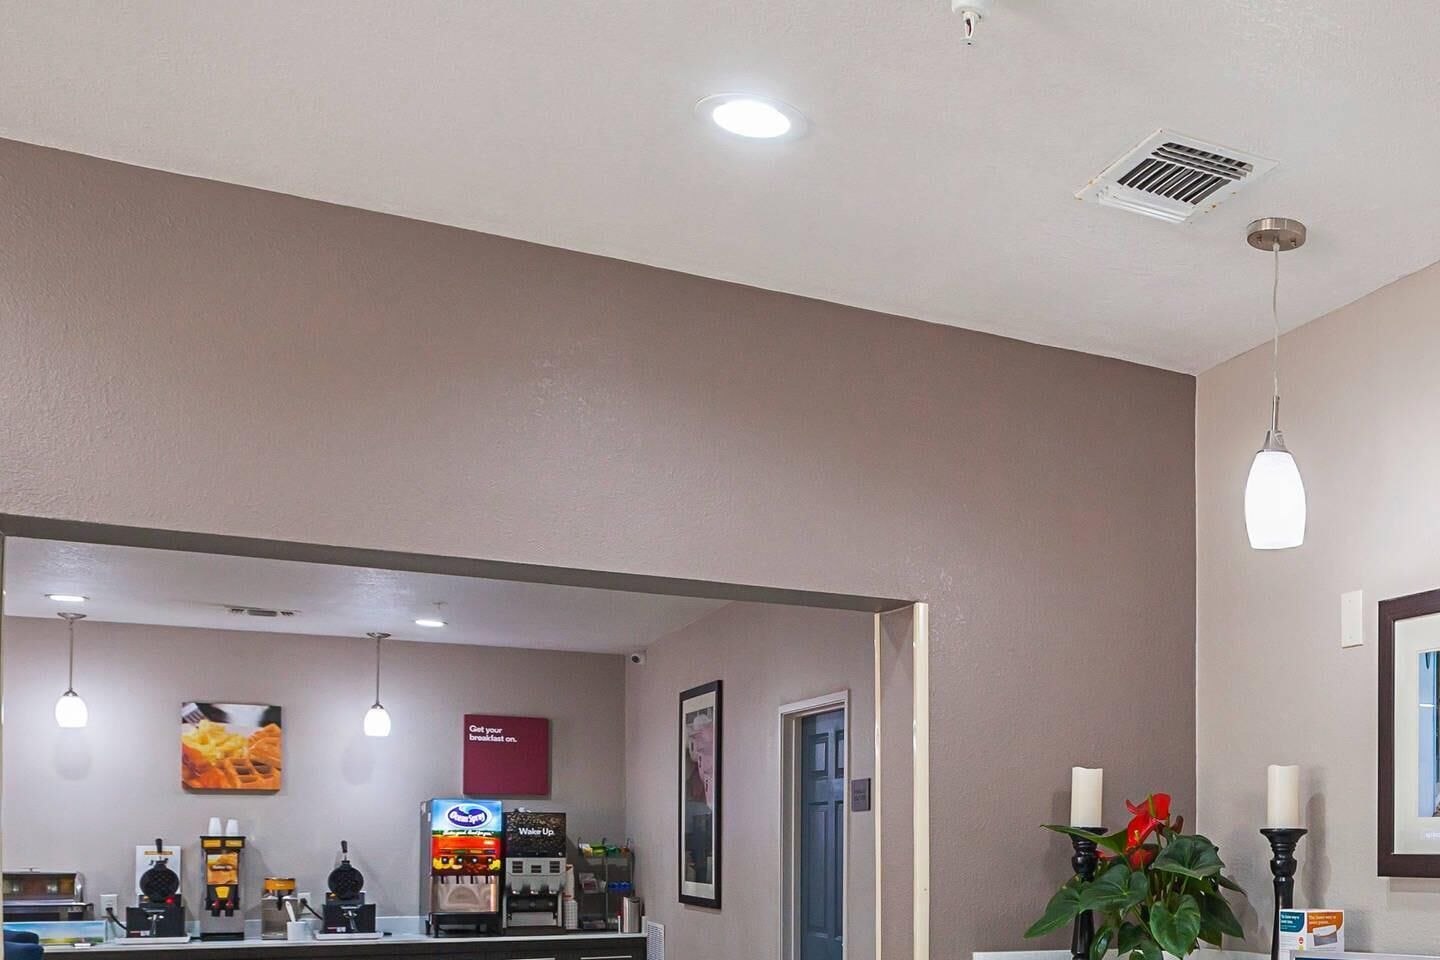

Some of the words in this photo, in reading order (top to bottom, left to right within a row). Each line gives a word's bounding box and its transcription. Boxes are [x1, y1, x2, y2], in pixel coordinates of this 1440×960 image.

[469, 725, 485, 733] Get
[485, 727, 503, 735] your
[469, 733, 505, 742] breakfast
[518, 827, 541, 836] Wake
